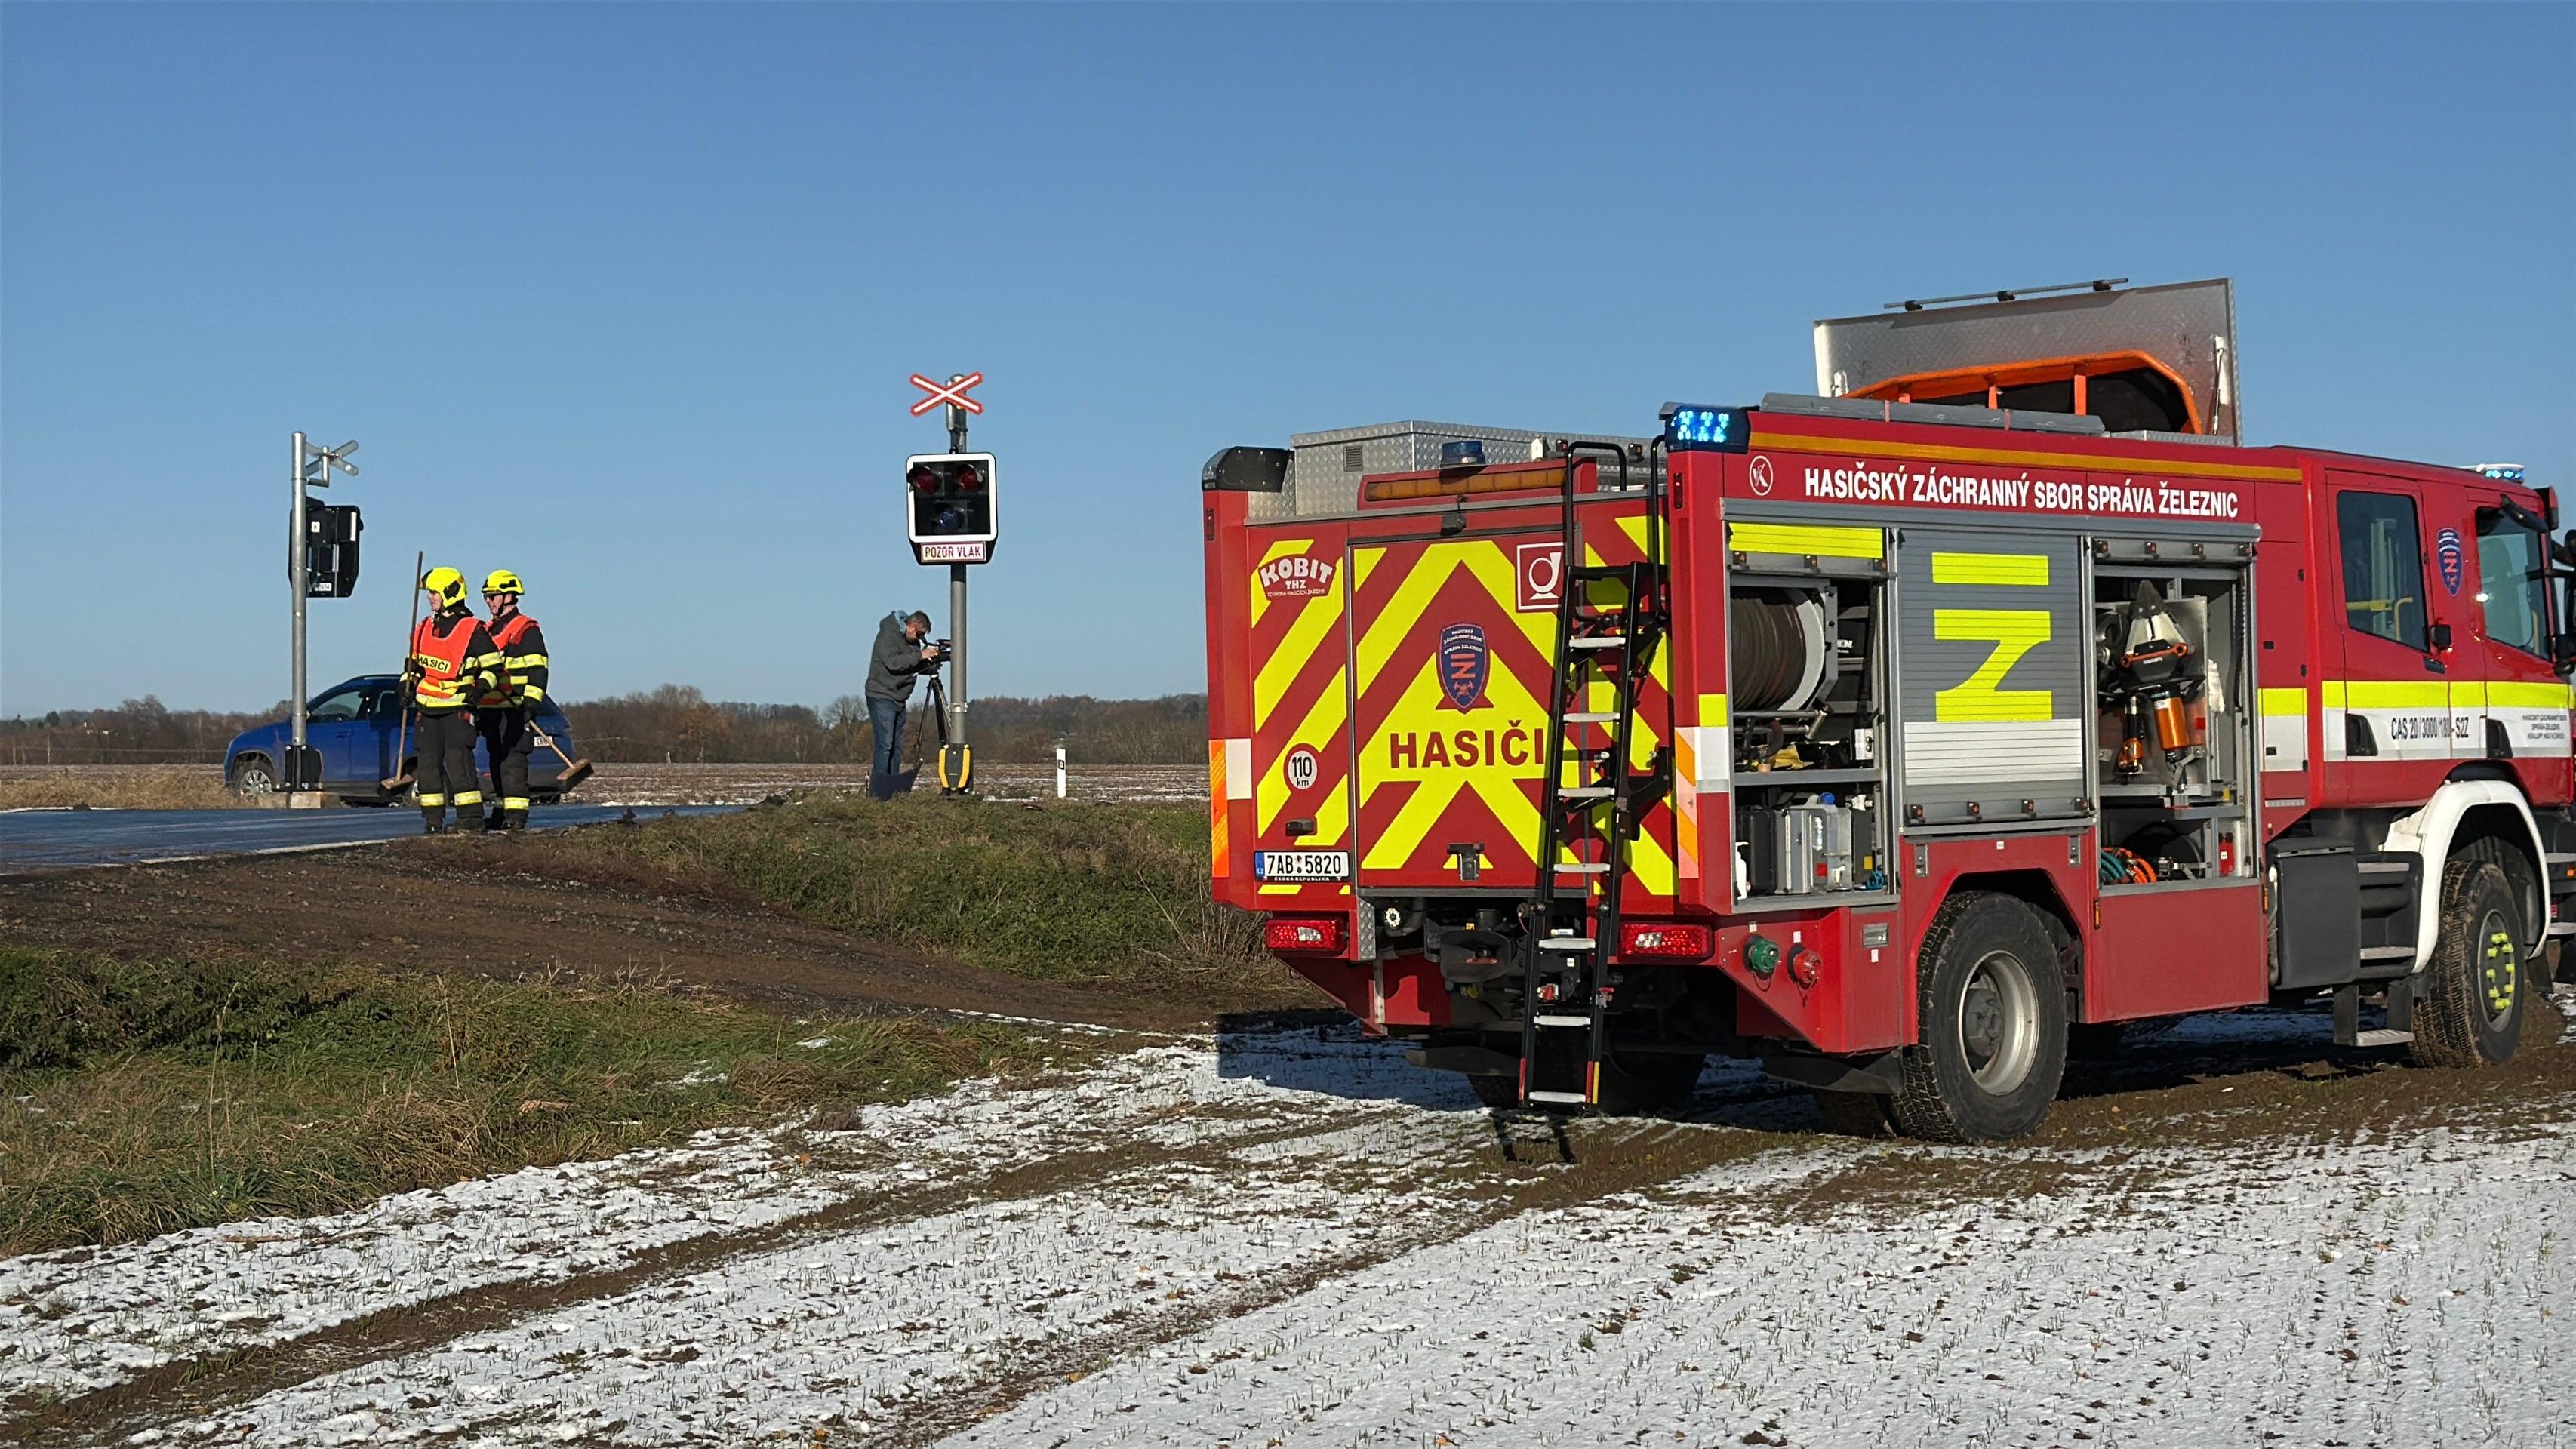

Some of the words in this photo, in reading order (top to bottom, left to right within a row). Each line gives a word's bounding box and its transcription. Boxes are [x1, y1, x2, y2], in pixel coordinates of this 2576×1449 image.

[1805, 461, 1908, 501] HASIČSKÝ
[1912, 466, 2030, 507] ZÁCHRANNÝ
[2034, 480, 2083, 510] SBOR
[2088, 478, 2156, 514] SPRÁVA
[2159, 481, 2239, 518] ŽELEZNIC
[925, 546, 954, 558] POZOR
[957, 546, 981, 558] VLAK
[1260, 558, 1333, 588] KOBIT
[1285, 580, 1307, 589] THZ
[2391, 717, 2408, 740] CAS
[1390, 719, 1544, 768] HASIČI
[1291, 756, 1313, 778] 110
[1296, 778, 1310, 787] km
[1267, 854, 1294, 875] 7AB
[1304, 854, 1341, 875] 5820
